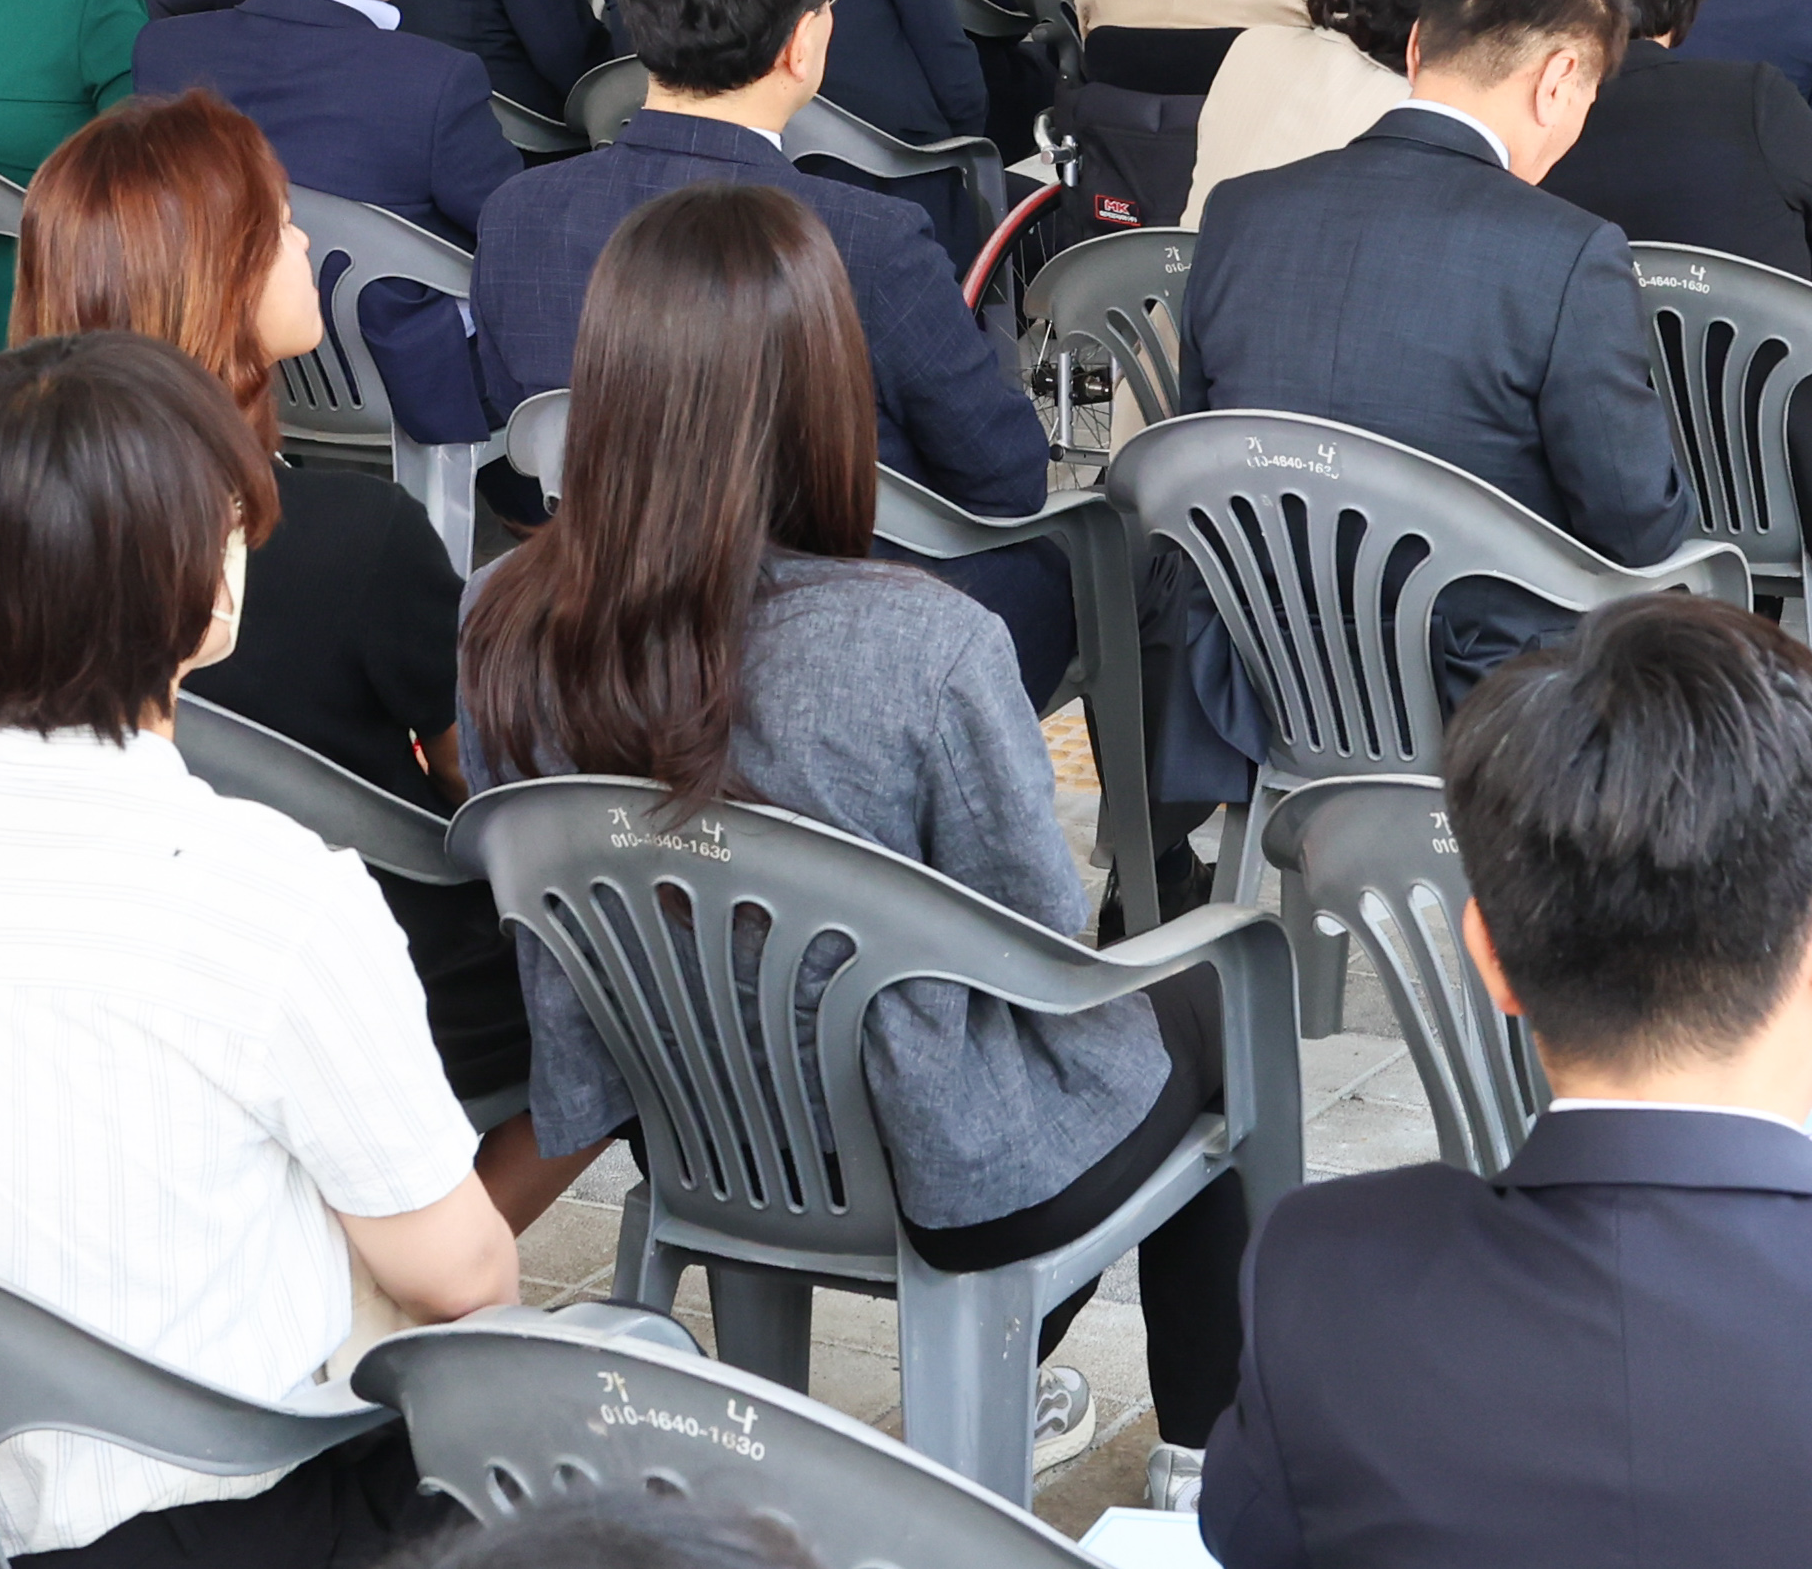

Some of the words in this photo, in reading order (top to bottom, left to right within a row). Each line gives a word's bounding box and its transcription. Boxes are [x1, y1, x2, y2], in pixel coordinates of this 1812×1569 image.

[1104, 199, 1130, 215] MK
[1638, 276, 1710, 294] 0-4640-1630
[597, 1371, 629, 1403] 가
[600, 1403, 766, 1461] 010-4640-1630
